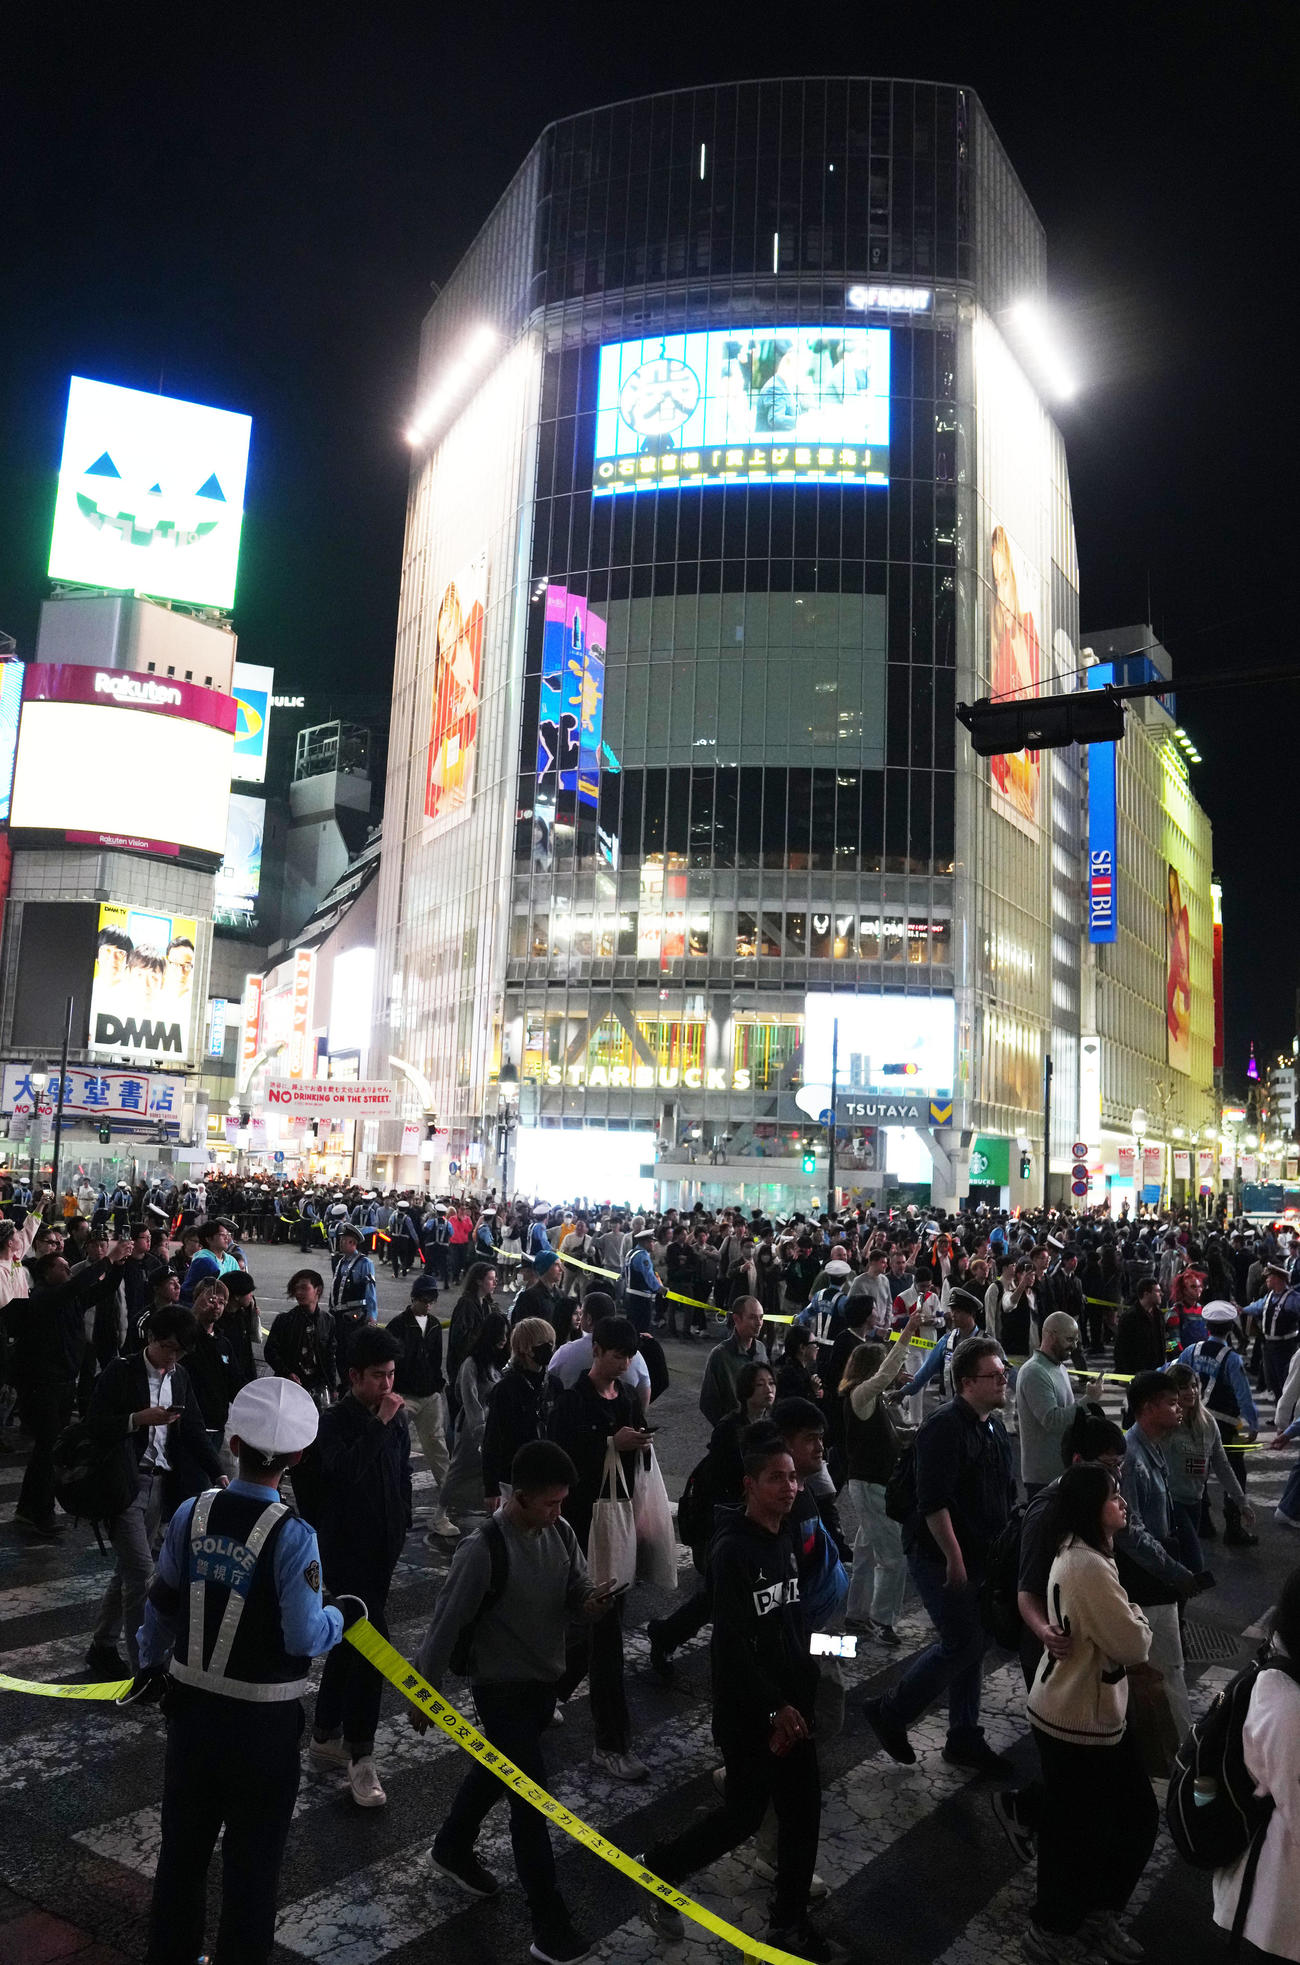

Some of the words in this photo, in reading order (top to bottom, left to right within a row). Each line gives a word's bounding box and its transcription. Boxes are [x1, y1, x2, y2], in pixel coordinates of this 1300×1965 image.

[94, 673, 182, 705] Rakuten
[99, 835, 128, 846] Rakuten
[128, 838, 149, 848] Vision
[1091, 850, 1112, 928] SEIBU
[95, 1013, 182, 1053] DMM
[547, 1065, 751, 1090] STARBUCKS
[13, 1074, 175, 1112] 大盛堂書店
[268, 1089, 292, 1104] NO
[294, 1092, 331, 1103] DRINKING
[333, 1094, 345, 1103] ON
[348, 1095, 362, 1104] THE
[14, 1104, 30, 1114] NO
[38, 1106, 53, 1116] NO
[226, 1116, 240, 1125] NO
[846, 1103, 919, 1118] TSUTAYA
[191, 1537, 256, 1572] POLICE
[196, 1559, 249, 1586] 警視庁
[401, 1674, 621, 1860] 警察官の交通整理にご協力下さい
[638, 1871, 690, 1908] 警視庁
